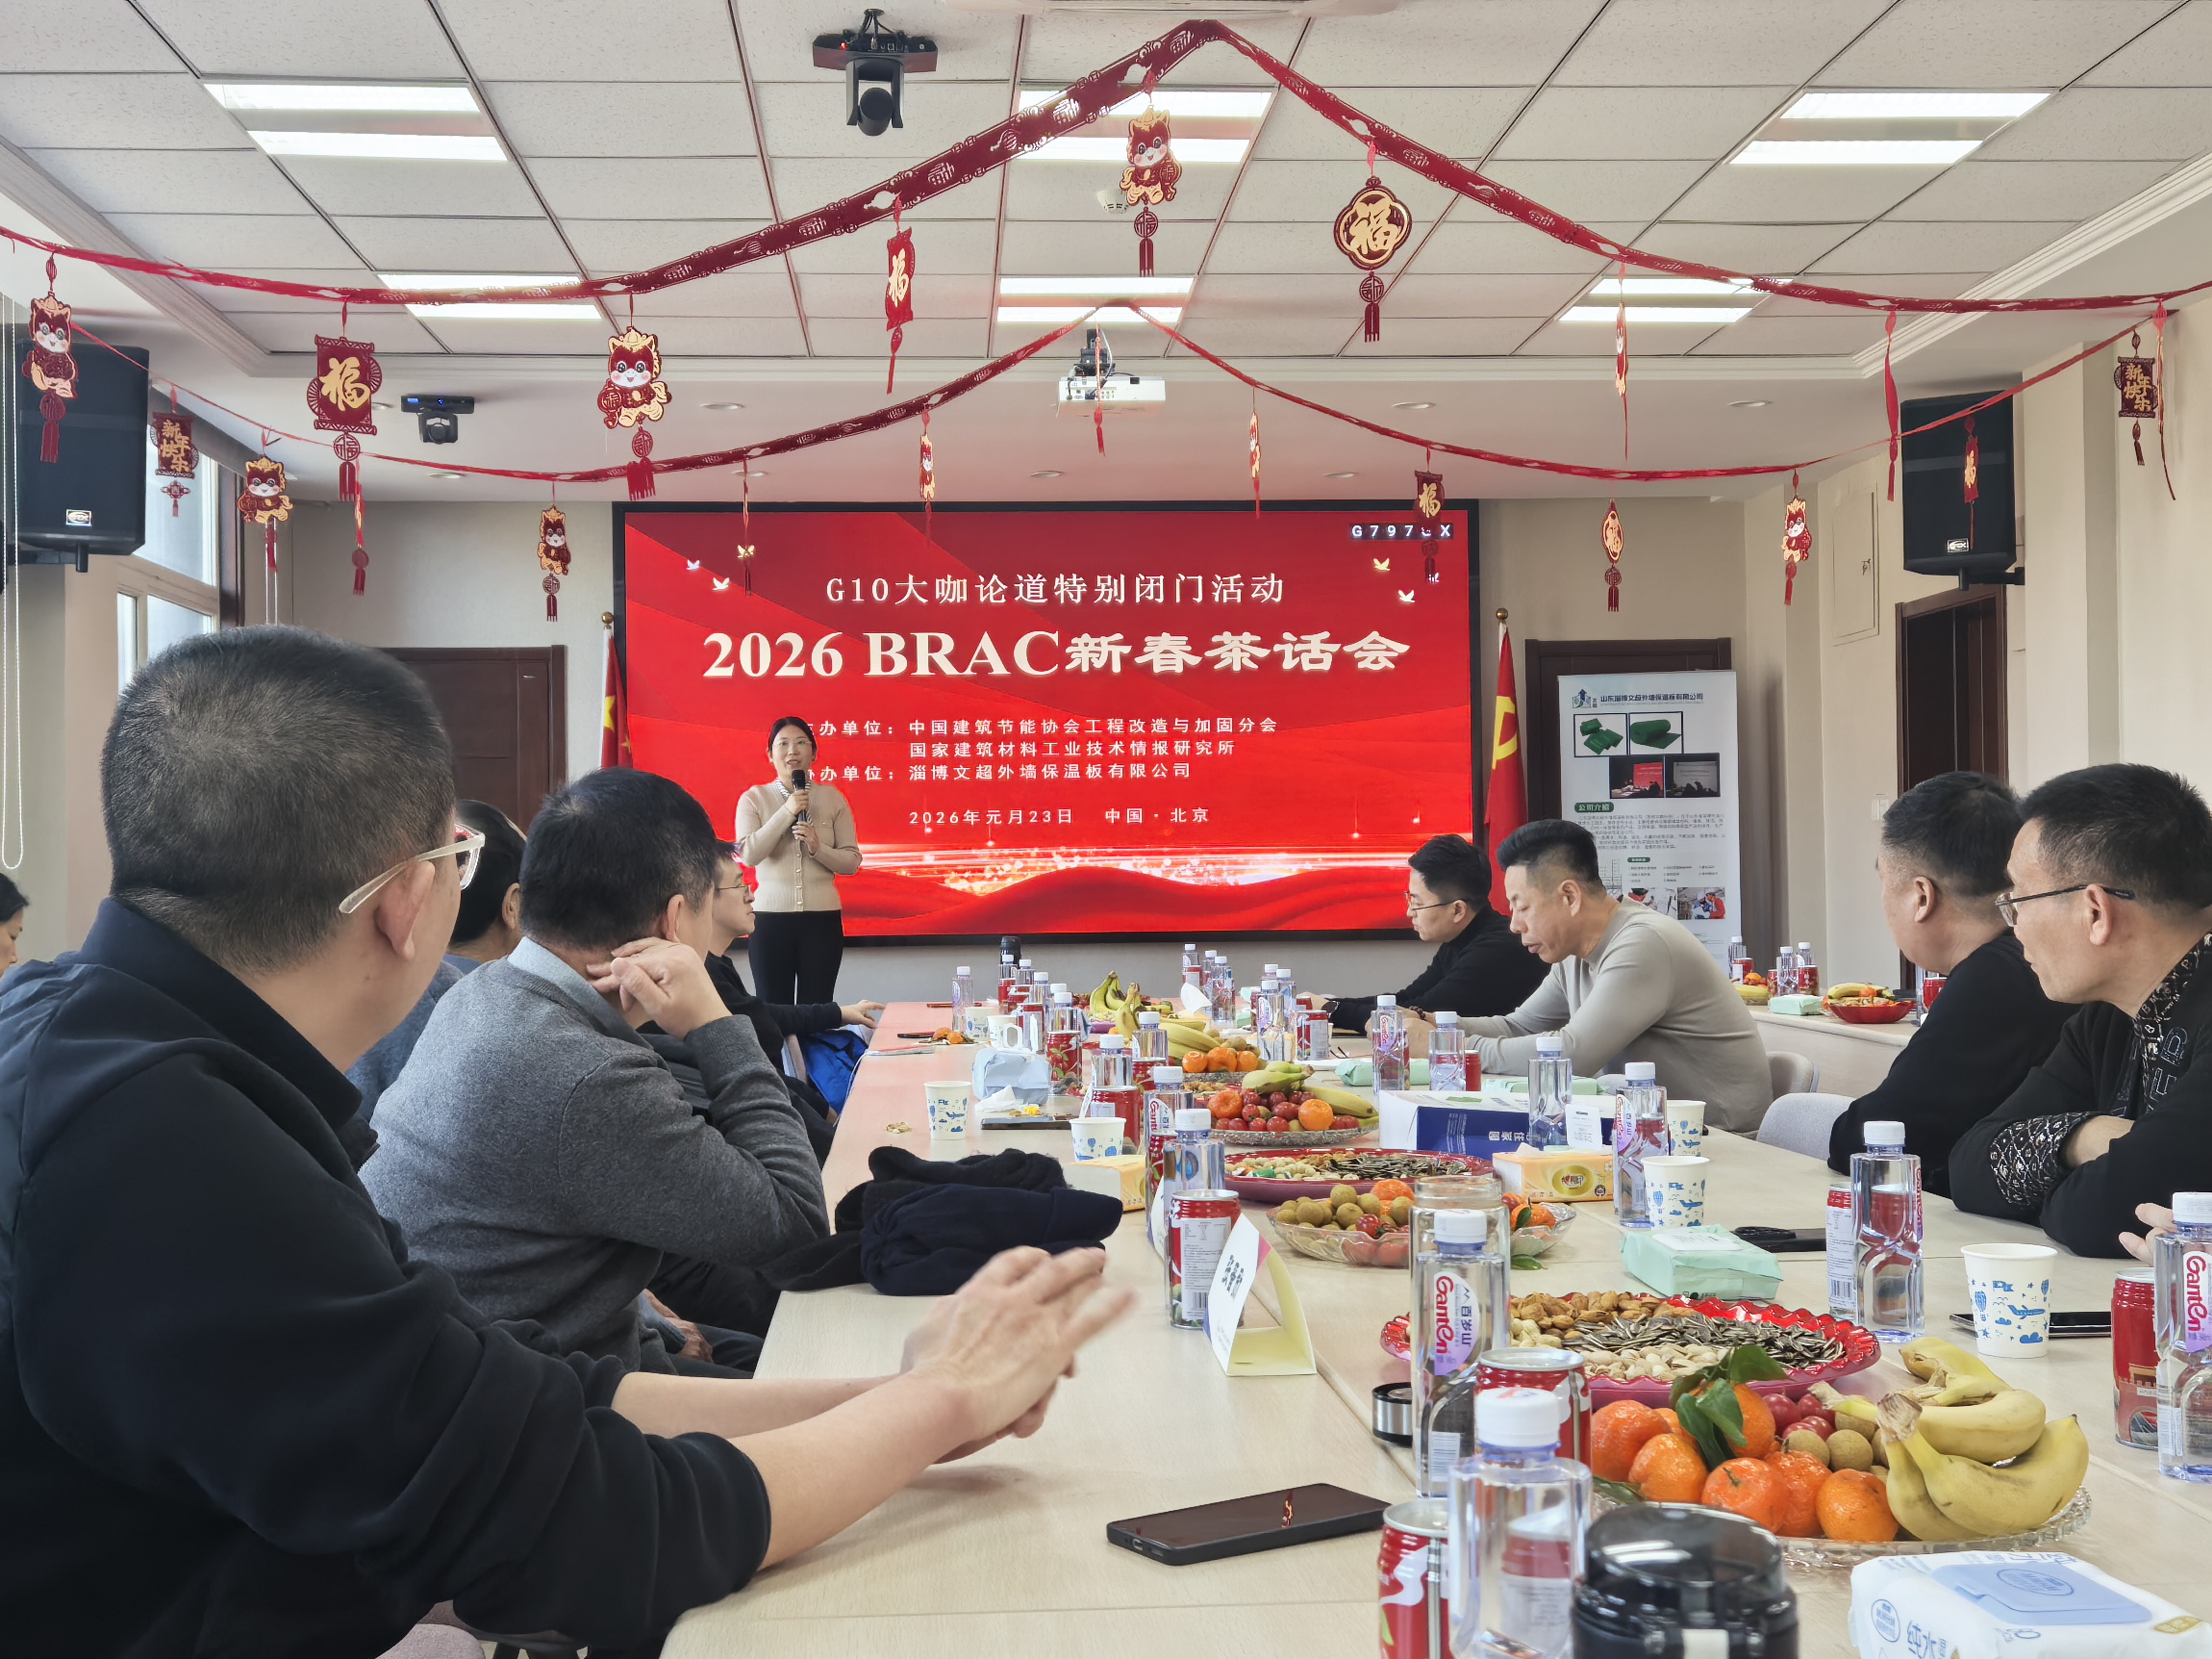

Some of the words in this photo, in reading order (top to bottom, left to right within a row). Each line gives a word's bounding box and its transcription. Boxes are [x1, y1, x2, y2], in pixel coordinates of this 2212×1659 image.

[1349, 202, 1400, 254] 福
[889, 247, 909, 307] 福
[319, 356, 371, 412] 福
[1418, 482, 1441, 518] 福
[827, 573, 1283, 604] G10大咖论道特别闭门活动
[703, 631, 843, 677] 2026
[863, 630, 1410, 676] BRAC新春茶话会
[909, 717, 1277, 735] 中国建筑节能协会工程改造与加固分会
[910, 740, 1235, 758] 国家建筑材料工业技术情报研究所
[908, 763, 1191, 781] 淄博文超外墙保温板有限公司
[909, 808, 1073, 825] 2026年元月23日
[2186, 1255, 2208, 1332] Ganten
[1436, 1276, 1454, 1354] Ganten
[1461, 1305, 1472, 1346] 百岁山
